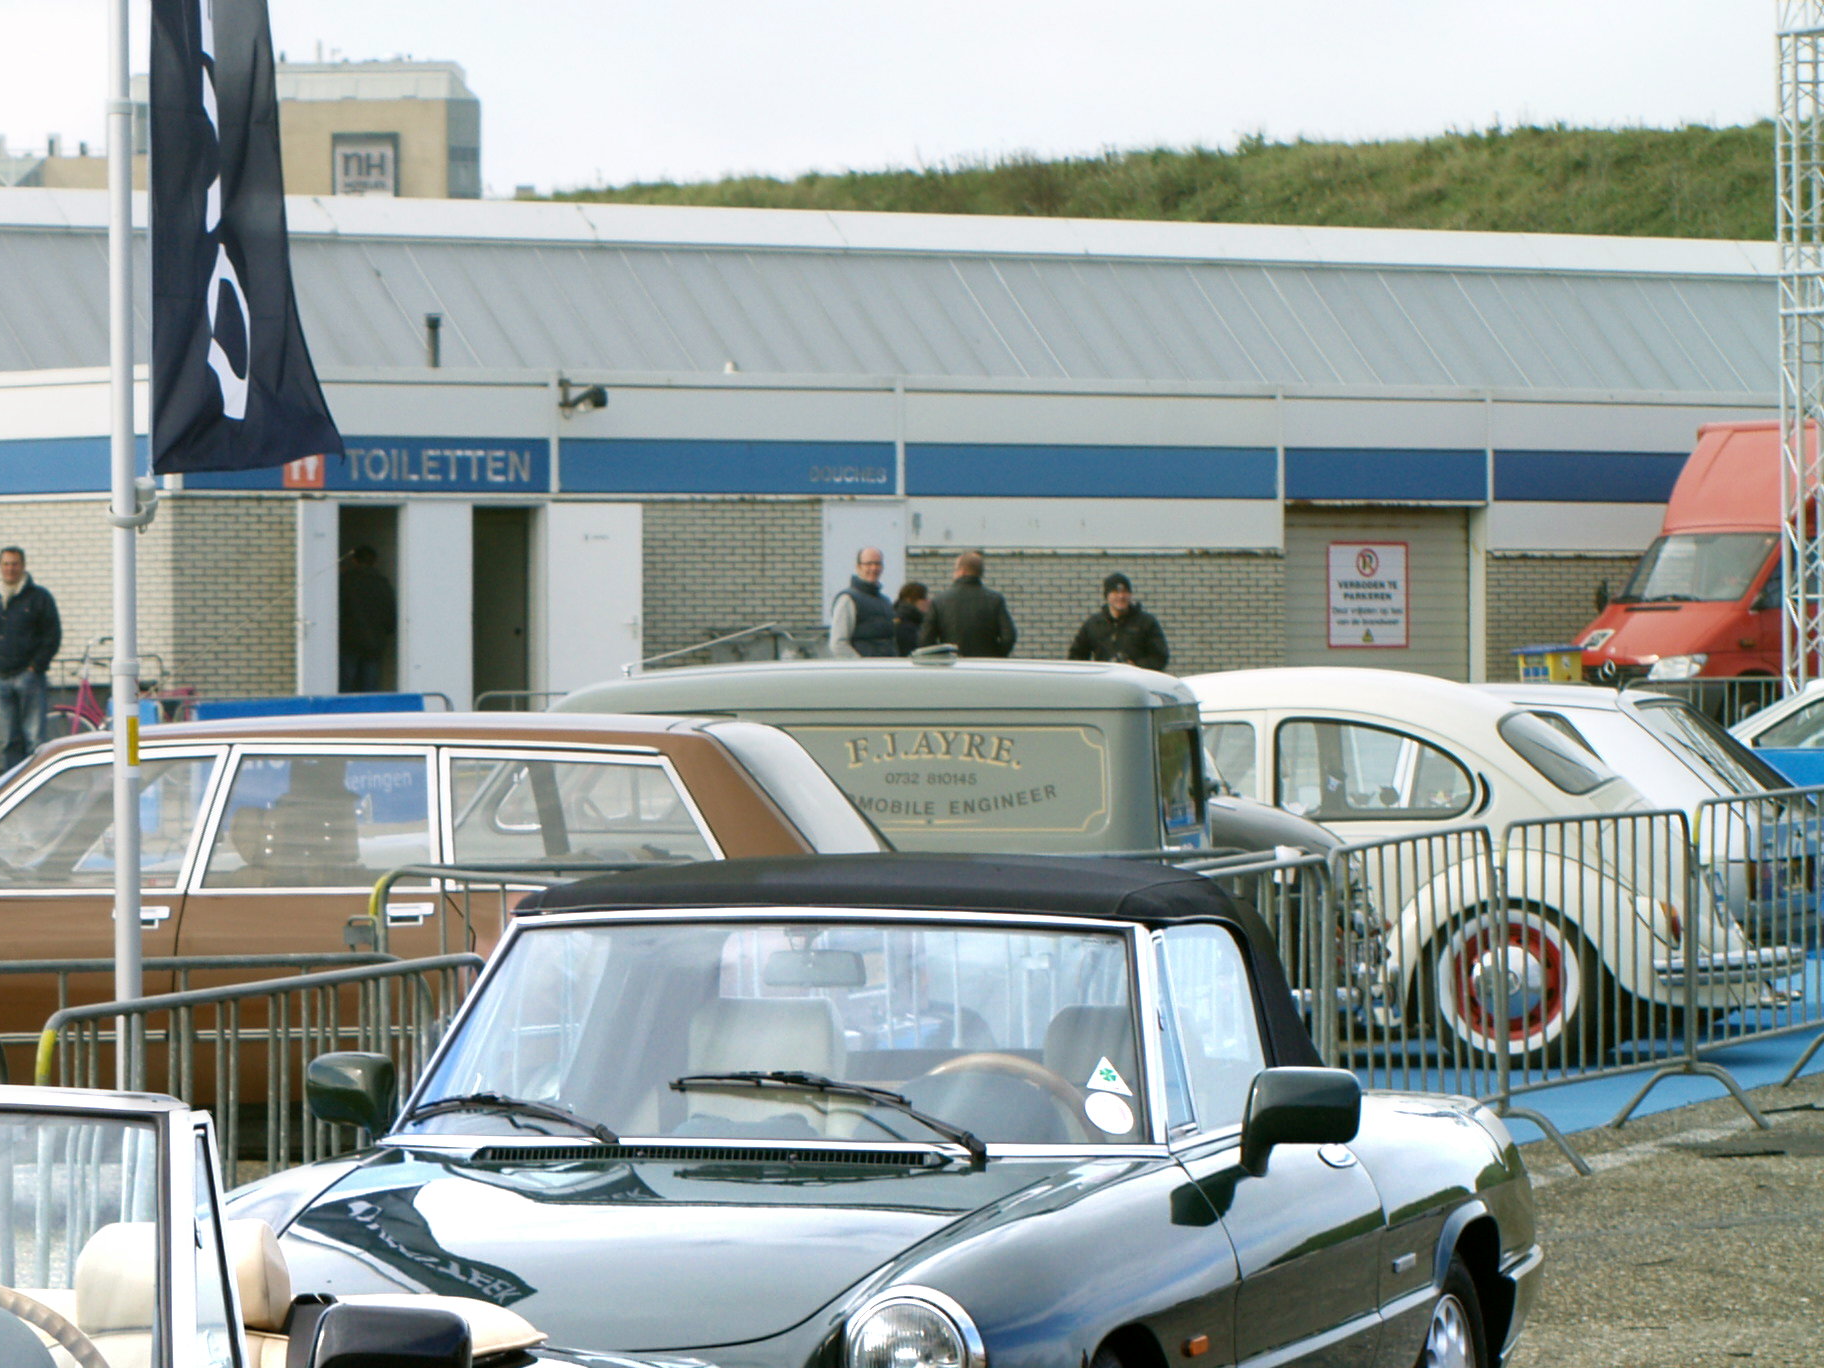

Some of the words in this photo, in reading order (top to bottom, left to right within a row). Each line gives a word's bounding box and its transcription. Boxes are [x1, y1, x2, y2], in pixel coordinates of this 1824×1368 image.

[347, 449, 531, 482] TOILETTEN
[885, 773, 919, 785] 0732
[949, 784, 1057, 816] ENGINEER
